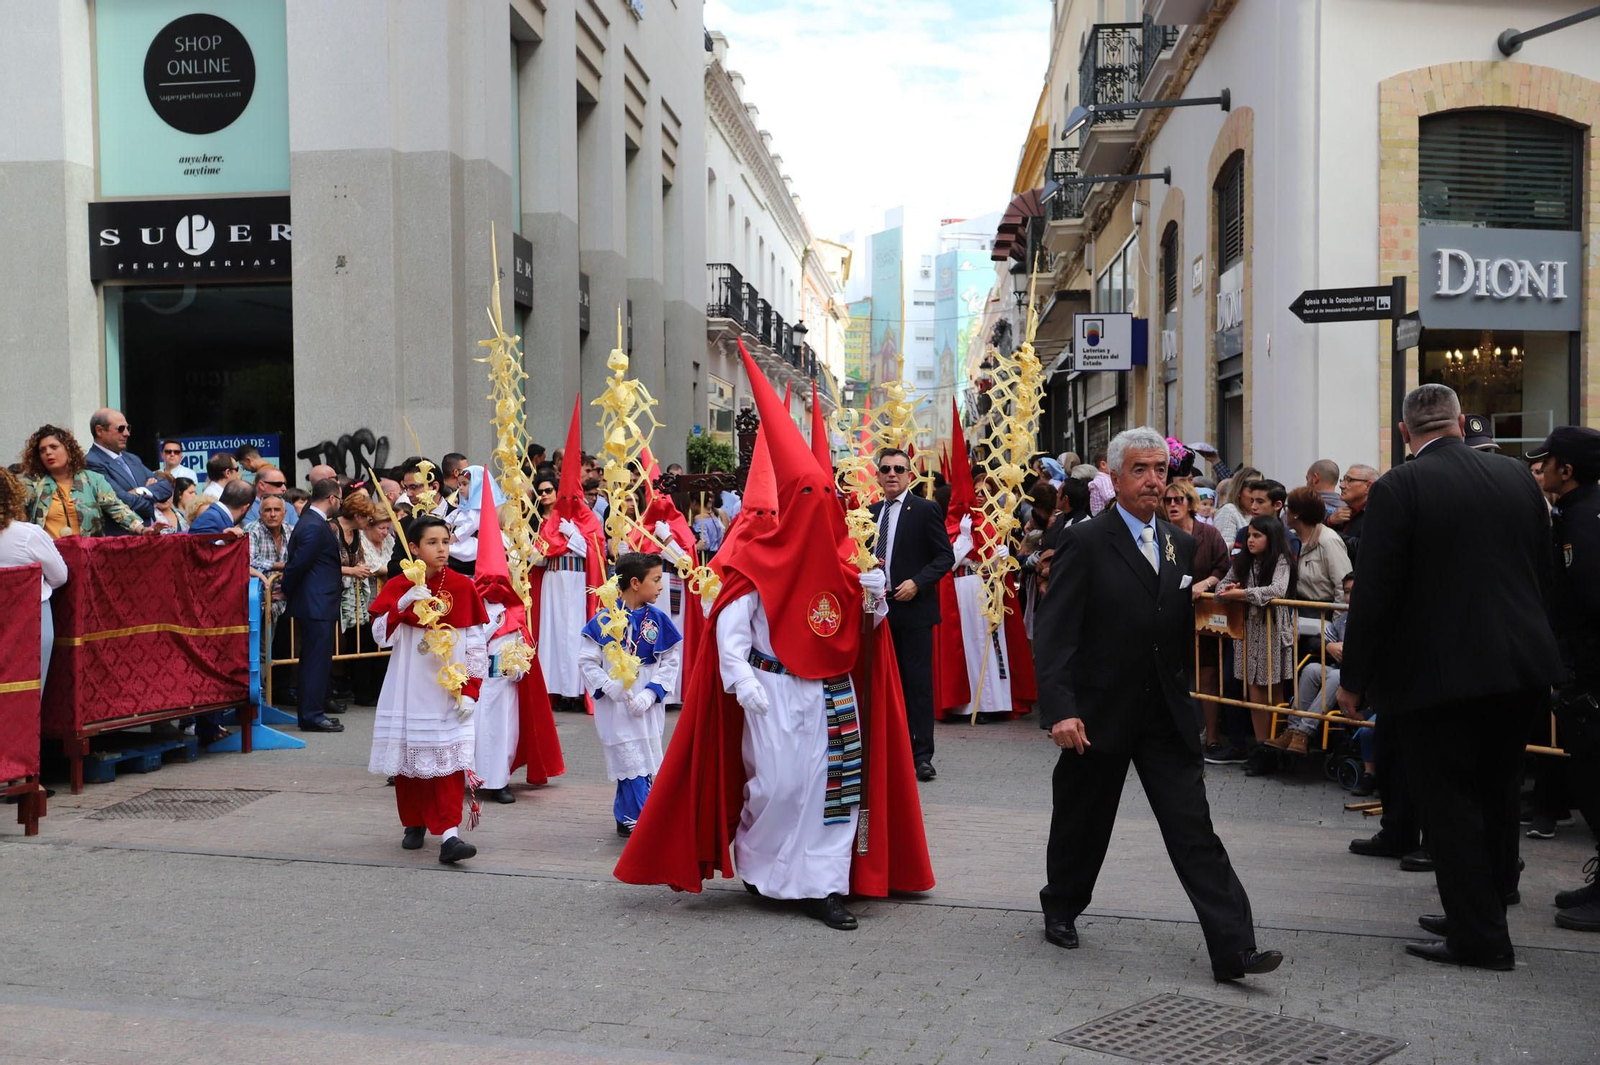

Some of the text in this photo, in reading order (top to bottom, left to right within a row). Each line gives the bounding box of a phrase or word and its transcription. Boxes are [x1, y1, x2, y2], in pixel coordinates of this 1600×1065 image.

[174, 35, 222, 53] SHOP
[166, 58, 231, 76] ONLINE
[183, 165, 221, 177] anytime
[99, 214, 292, 256] SUPER
[118, 258, 276, 270] PERFUMERIAS
[1435, 248, 1568, 299] DIONI
[188, 438, 248, 451] OPERACIÓN
[250, 439, 265, 447] DE
